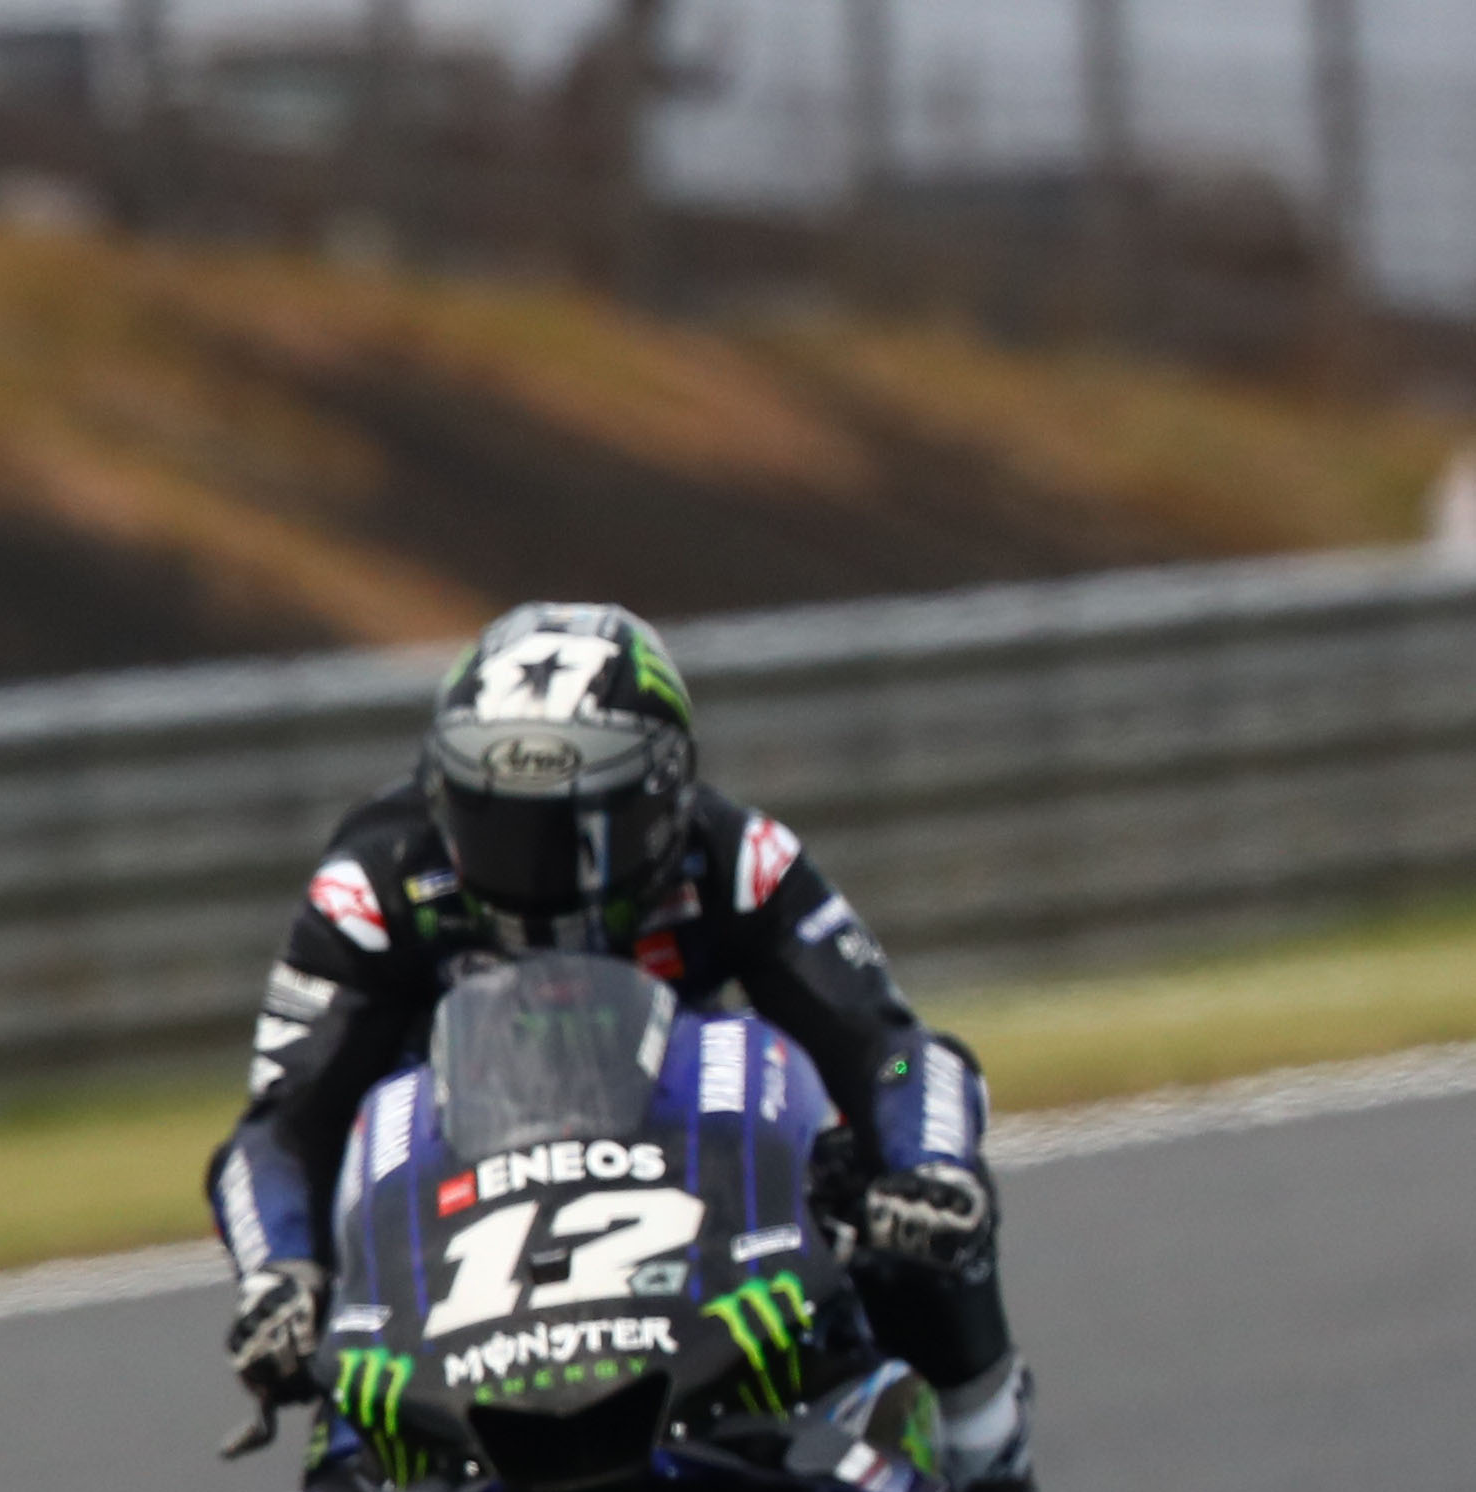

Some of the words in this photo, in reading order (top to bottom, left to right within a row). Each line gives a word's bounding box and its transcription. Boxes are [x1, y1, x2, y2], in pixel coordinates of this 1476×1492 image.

[475, 1139, 667, 1201] ENEOS
[422, 1187, 706, 1340] 12
[444, 1315, 679, 1388] MONSTER
